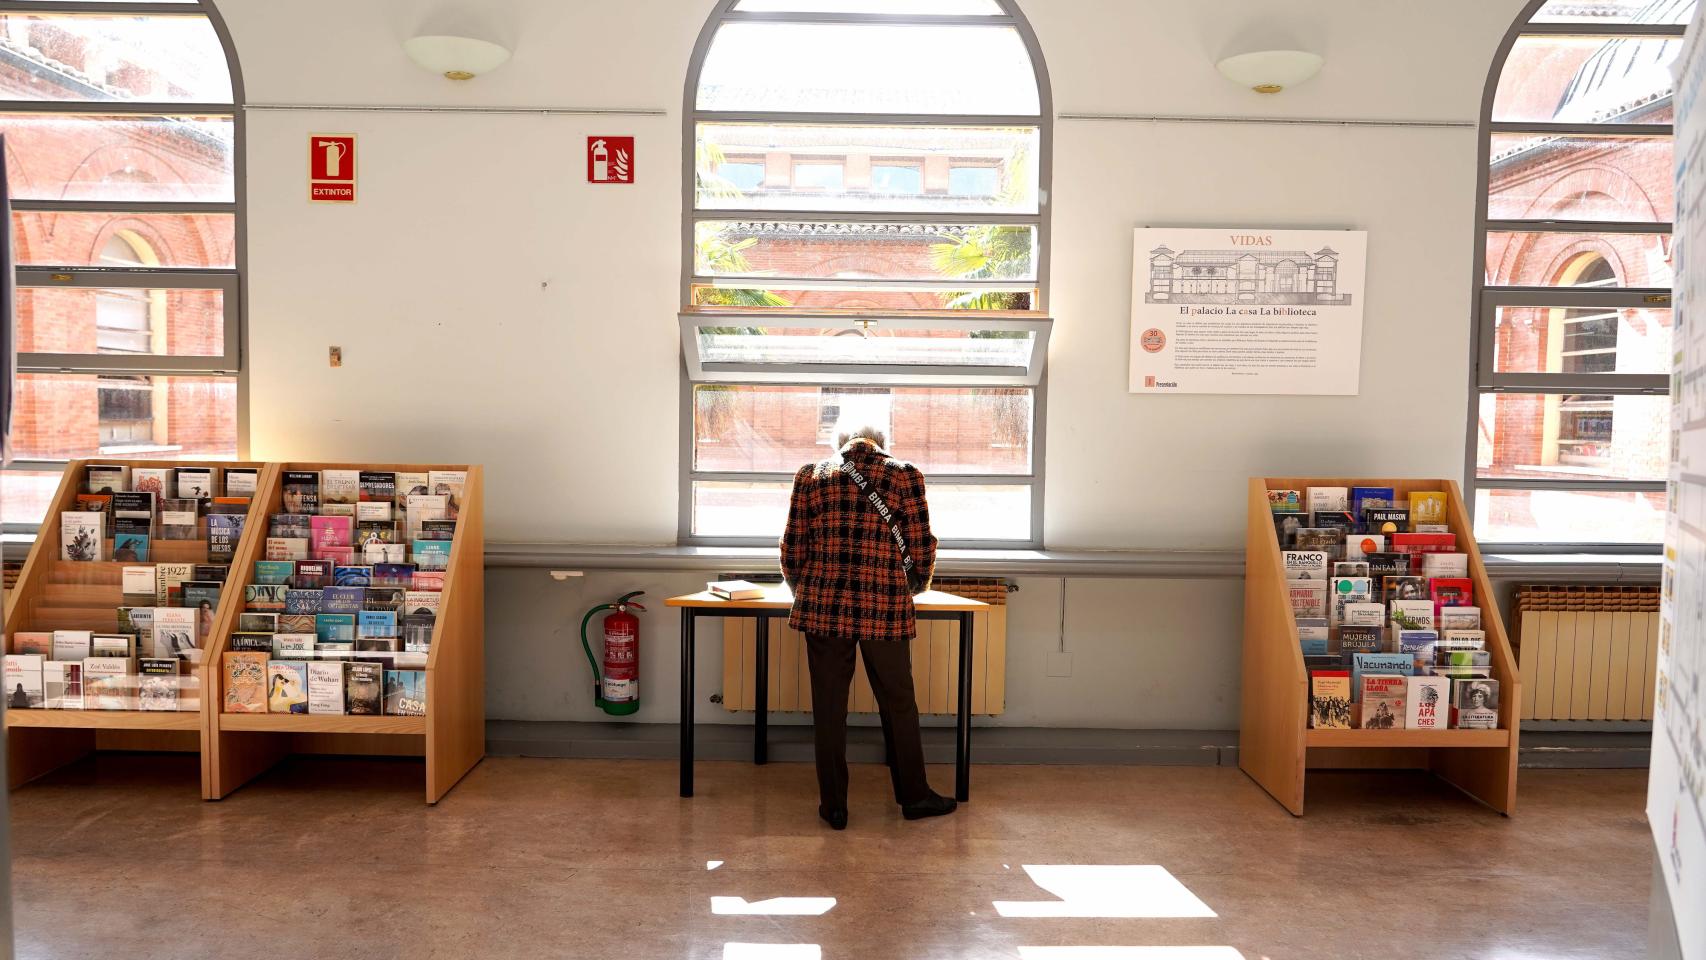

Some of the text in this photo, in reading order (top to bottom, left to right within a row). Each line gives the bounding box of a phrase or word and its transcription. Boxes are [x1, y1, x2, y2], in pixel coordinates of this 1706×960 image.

[1230, 235, 1272, 246] VIDAS
[1180, 306, 1189, 314] El
[1192, 306, 1223, 317] palacio
[1226, 307, 1236, 315] La
[1260, 307, 1270, 316] La
[1273, 306, 1316, 316] biblioteca
[841, 461, 868, 490] BIMBA
[868, 492, 892, 522] BIMBA
[1388, 513, 1406, 522] MASON
[891, 525, 906, 554] BIMBA
[168, 566, 187, 576] 1927
[233, 638, 240, 647] LA
[1357, 656, 1412, 669] Vacunando
[399, 698, 426, 712] CASA
[1419, 709, 1435, 717] APA
